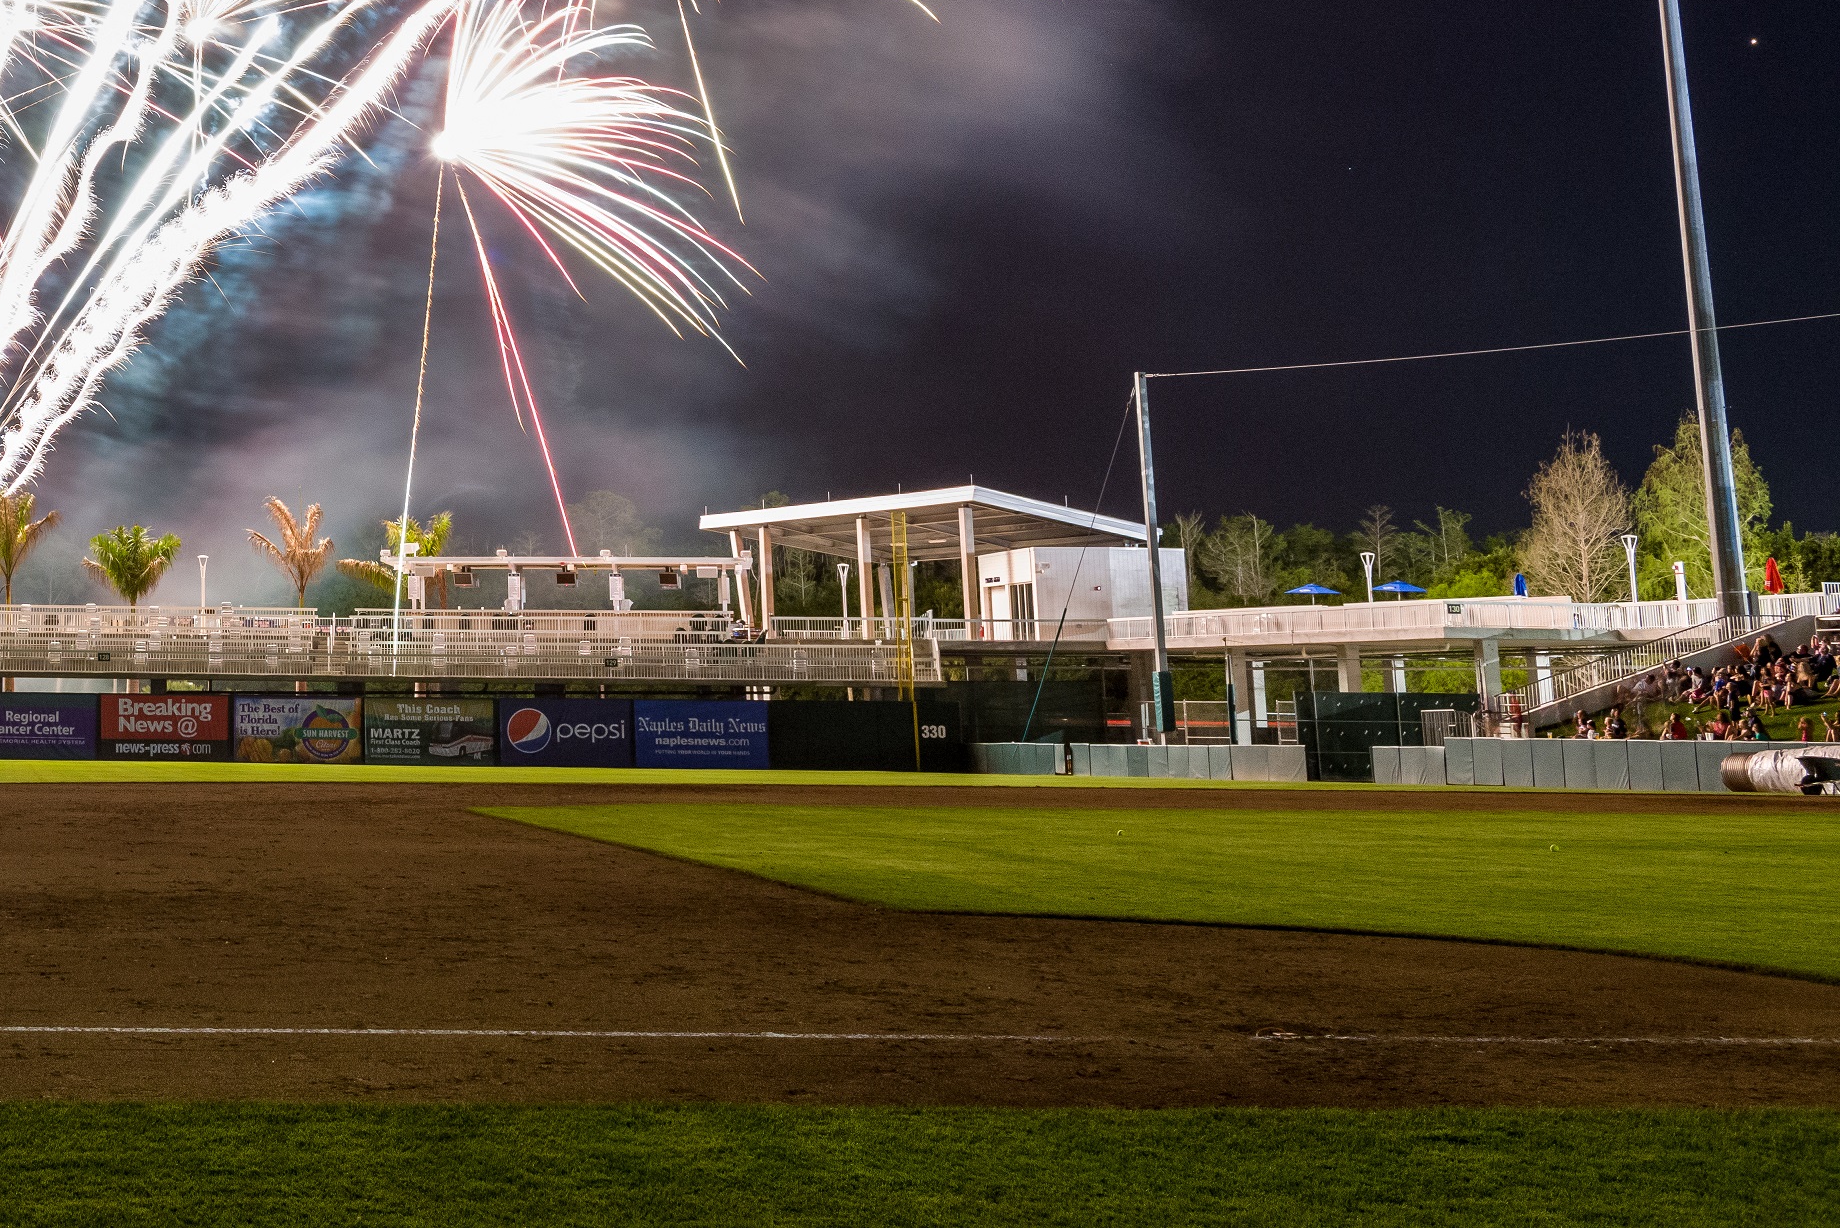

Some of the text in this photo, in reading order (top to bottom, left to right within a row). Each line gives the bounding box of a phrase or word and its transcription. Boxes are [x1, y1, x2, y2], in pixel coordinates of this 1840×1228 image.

[1448, 605, 1460, 613] 130
[98, 653, 110, 661] 128
[606, 659, 617, 667] 129
[118, 698, 213, 722] Breaking
[239, 703, 300, 714] The Best of
[396, 703, 461, 714] This Coach
[5, 710, 60, 725] Regional
[239, 714, 278, 725] Florida
[34, 723, 75, 735] Center
[118, 716, 198, 738] News @
[240, 725, 281, 736] is Here!
[556, 719, 626, 743] pepsi
[638, 716, 766, 736] Naples Daily News
[921, 724, 947, 739] 330
[302, 729, 349, 738] SUN HARVEST
[370, 728, 421, 739] MARTZ
[655, 735, 750, 747] naplesnews.com
[115, 742, 180, 757] news-press
